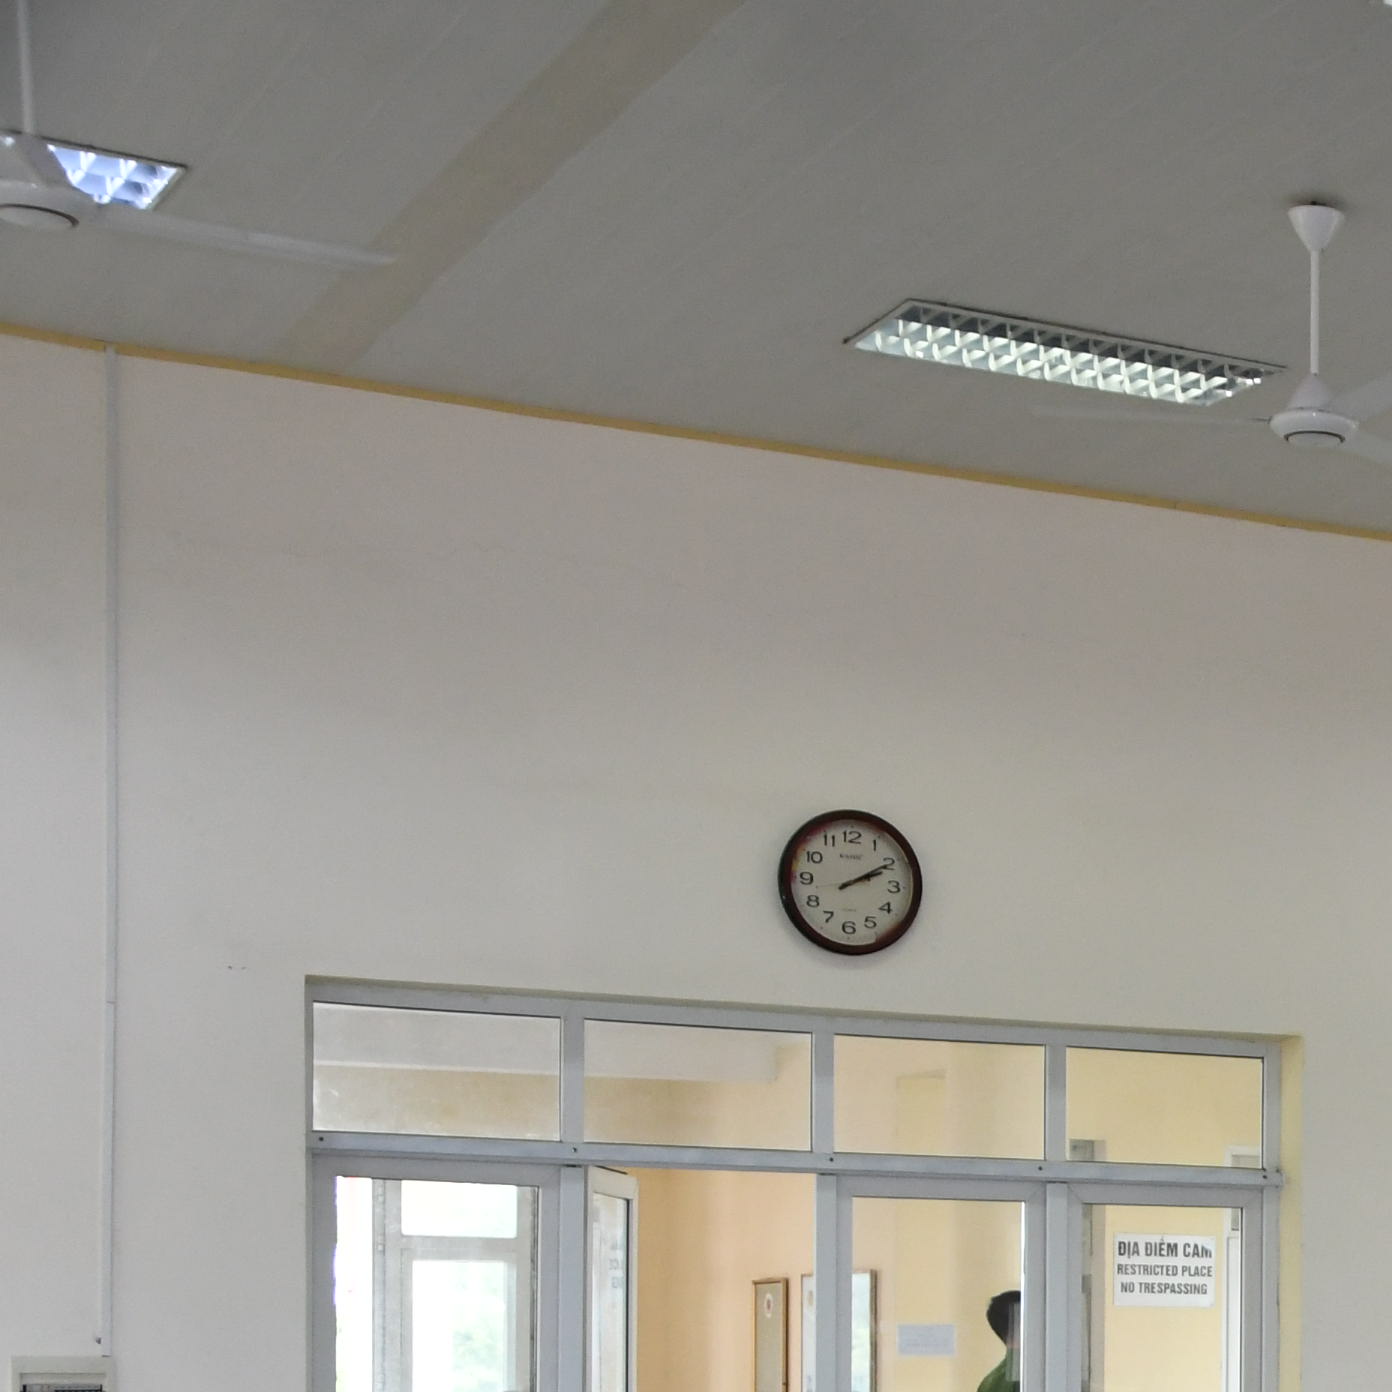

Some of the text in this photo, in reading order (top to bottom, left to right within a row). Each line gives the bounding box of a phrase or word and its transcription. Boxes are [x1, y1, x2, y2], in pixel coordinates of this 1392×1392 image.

[824, 834, 836, 847] 11
[843, 830, 862, 845] 12
[872, 839, 877, 852] 1
[806, 851, 823, 864] 10
[883, 857, 895, 870] 2
[800, 872, 814, 885] 9
[887, 880, 901, 894] 3
[806, 895, 820, 908] 8
[879, 901, 893, 914] 4
[823, 910, 834, 923] 7
[864, 916, 877, 929] 5
[842, 921, 856, 934] 6
[1118, 1241, 1140, 1259] ĐỊA
[1117, 1263, 1213, 1277] RESTRICTED PLACE
[1120, 1282, 1208, 1295] NO TRESPASSING
